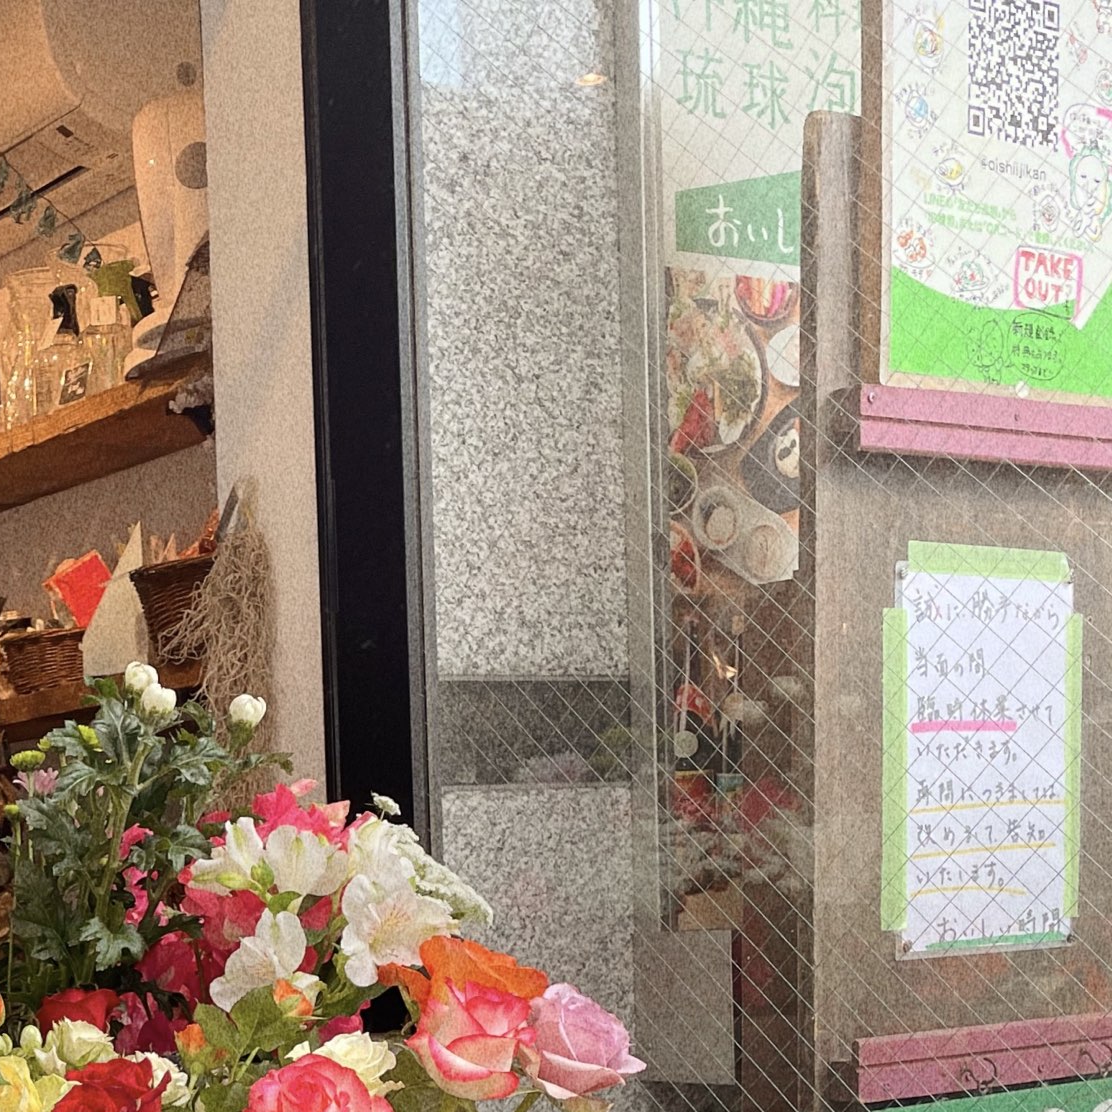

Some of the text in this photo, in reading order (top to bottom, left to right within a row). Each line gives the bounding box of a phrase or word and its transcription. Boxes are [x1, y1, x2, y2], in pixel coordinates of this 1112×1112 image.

[705, 194, 794, 254] おいし
[1019, 250, 1075, 280] TAKE
[1023, 277, 1064, 303] OUT
